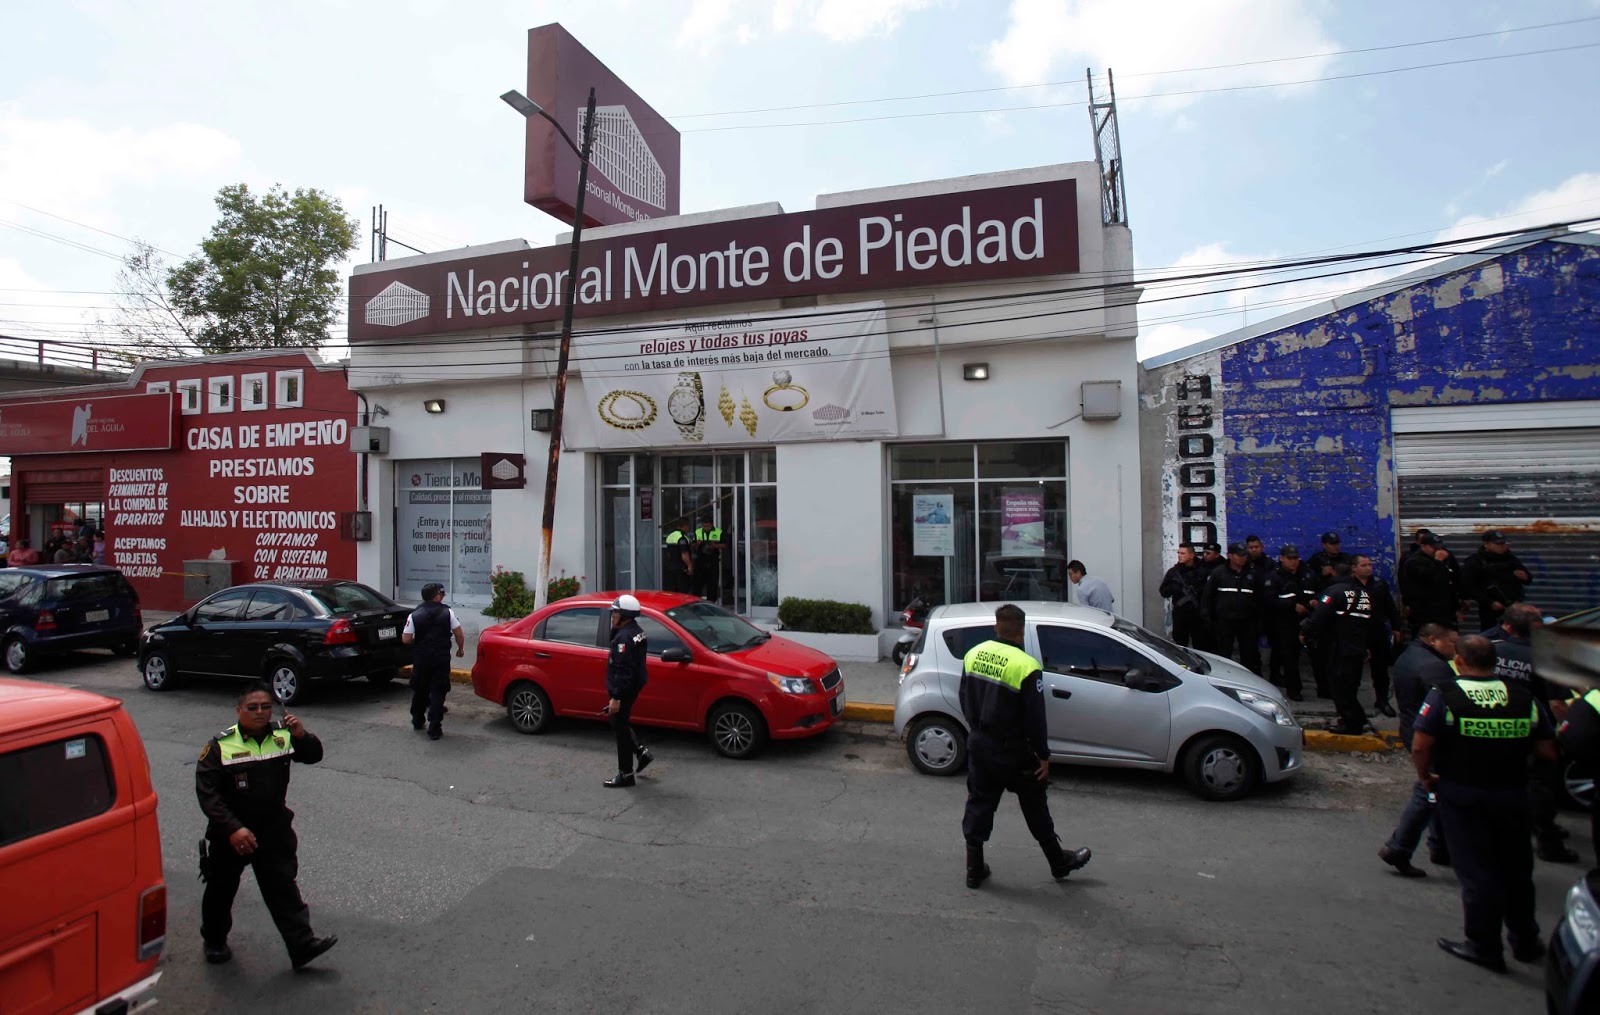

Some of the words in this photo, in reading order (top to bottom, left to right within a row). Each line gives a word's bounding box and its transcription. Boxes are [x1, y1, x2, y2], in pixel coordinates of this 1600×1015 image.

[578, 170, 611, 205] acional
[612, 192, 635, 219] Monte
[446, 250, 612, 319] Nacional
[623, 242, 769, 299] Monte
[783, 224, 844, 283] de
[859, 197, 1045, 275] Piedad
[640, 338, 685, 355] relojes
[689, 339, 697, 353] y
[701, 333, 739, 349] todas
[743, 332, 765, 346] tus
[769, 328, 808, 347] joyas
[624, 363, 640, 371] con
[641, 360, 650, 370] la
[653, 360, 672, 369] tasa
[674, 357, 685, 367] de
[687, 354, 719, 366] interés
[721, 353, 741, 364] más
[743, 351, 764, 363] baja
[766, 349, 782, 360] del
[784, 346, 831, 359] mercado.
[86, 425, 99, 433] DEL
[187, 426, 234, 450] CASA
[238, 425, 260, 449] DE
[265, 418, 347, 448] EMPEÑO
[209, 456, 315, 478] PRESTAMOS
[109, 468, 164, 482] DESCUENTOS
[424, 472, 461, 487] Tienda
[463, 472, 481, 487] Mo
[108, 483, 156, 497] PERMANENTES
[157, 482, 168, 496] EN
[233, 485, 290, 504] SOBRE
[108, 498, 121, 511] LA
[123, 497, 157, 511] COMPRA
[158, 497, 168, 511] DE
[114, 513, 165, 526] APARATOS
[180, 509, 227, 528] ALHAJAS
[229, 510, 240, 528] Y
[242, 510, 336, 530] ELECTRONICOS
[441, 519, 446, 528] y
[447, 518, 484, 527] encuentr
[255, 532, 319, 547] CONTAMOS
[412, 529, 424, 539] los
[114, 537, 166, 550] ACEPTAMOS
[412, 543, 427, 554] que
[113, 552, 158, 565] TARJETAS
[253, 548, 278, 563] CON
[280, 549, 328, 565] SISTEMA
[253, 565, 269, 580] DE
[274, 566, 328, 580] APARTADO
[975, 650, 1009, 668] SEGURIDAD
[1496, 656, 1532, 673] OLICIA
[972, 661, 1004, 679] CIUDADANA
[1493, 666, 1531, 681] NICIPAL
[1467, 689, 1508, 703] EGURID
[1463, 719, 1528, 730] POLICÍA
